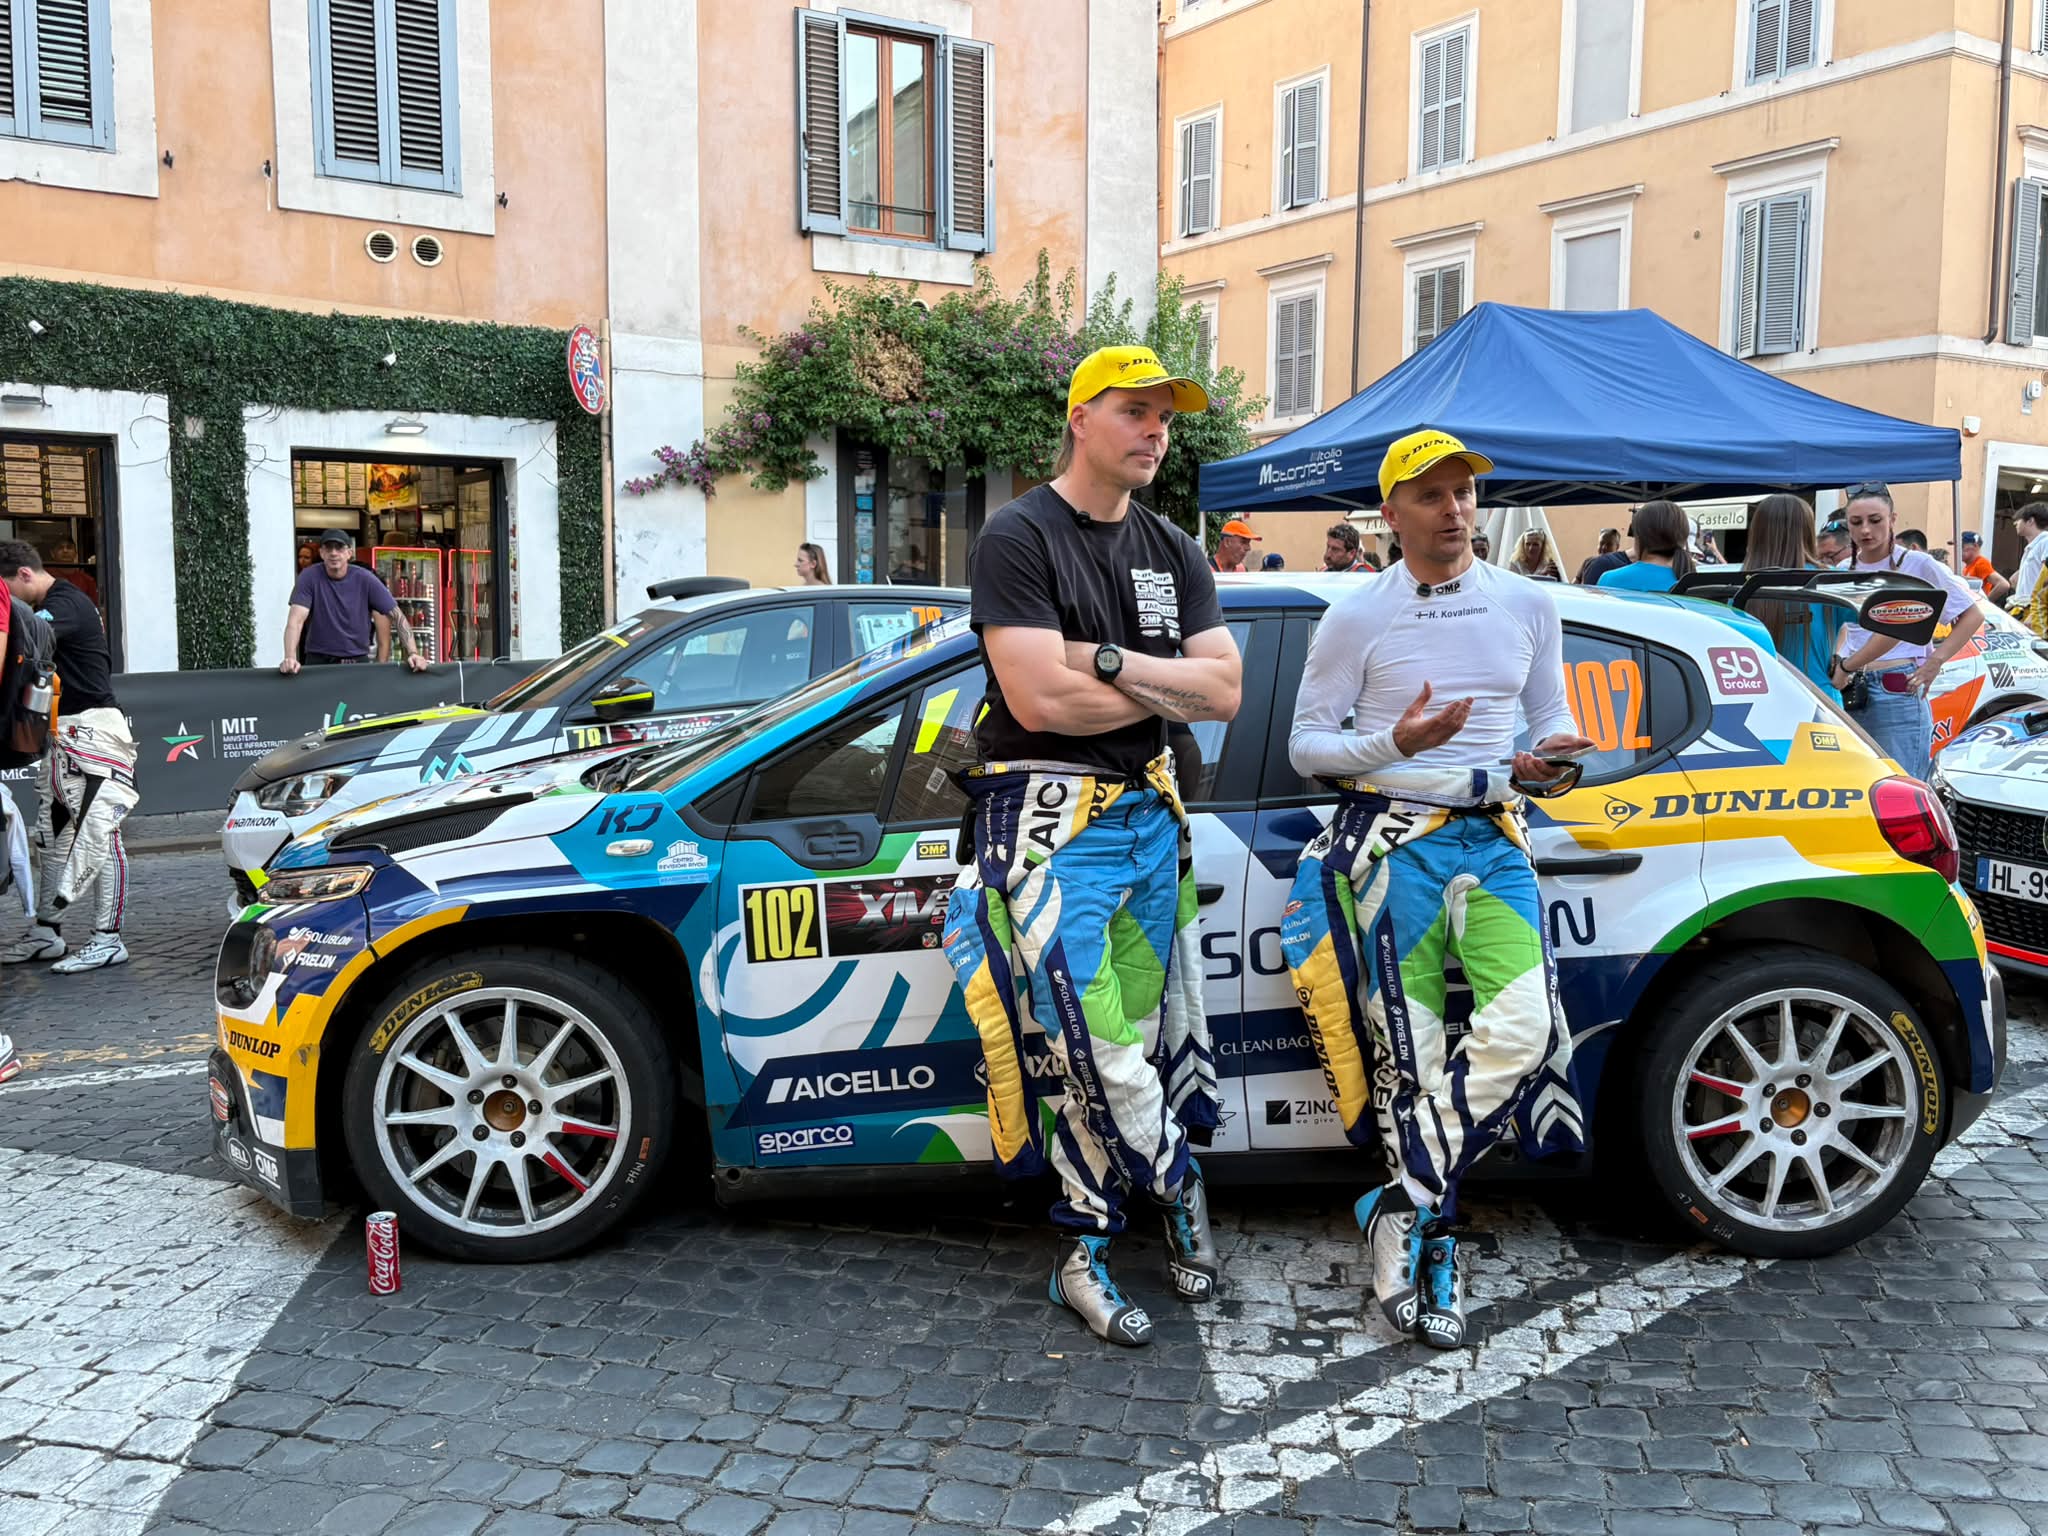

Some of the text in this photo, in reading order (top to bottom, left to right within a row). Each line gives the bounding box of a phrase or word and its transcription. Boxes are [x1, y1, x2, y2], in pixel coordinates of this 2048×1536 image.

[1697, 512, 1745, 525] Castello
[1435, 583, 1461, 595] OMP
[1441, 606, 1488, 618] Kovalainen
[1716, 650, 1760, 679] sb
[1722, 678, 1762, 690] broker
[222, 717, 258, 734] MIT
[1813, 735, 1837, 748] OMP
[1, 769, 29, 780] MiC
[1650, 788, 1863, 819] DUNLOP
[919, 844, 948, 855] OMP
[747, 887, 817, 960] 102
[303, 930, 353, 946] SOLUBLON
[1059, 985, 1082, 1039] SOLUBLON
[229, 1031, 281, 1058] DUNLOP
[1220, 1035, 1310, 1055] CLEAN BAG
[1394, 1017, 1409, 1061] FIXELON
[792, 1065, 935, 1101] AICELLO
[1077, 1061, 1098, 1097] FIXELON
[758, 1125, 853, 1152] sparco
[230, 1144, 249, 1164] BELL
[255, 1154, 279, 1181] OMP
